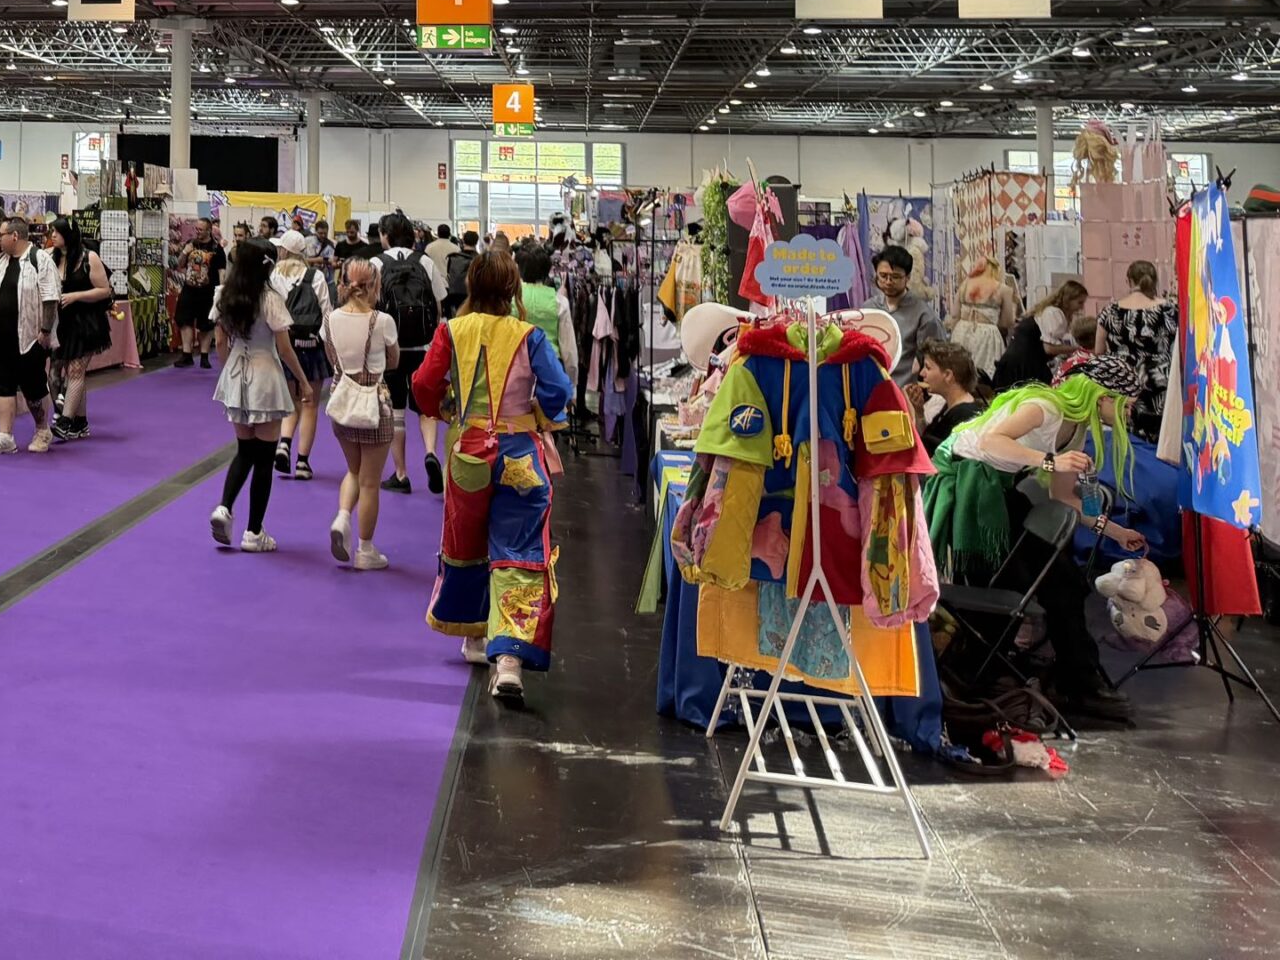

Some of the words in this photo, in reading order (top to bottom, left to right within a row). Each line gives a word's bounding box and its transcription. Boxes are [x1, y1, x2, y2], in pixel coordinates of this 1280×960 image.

[505, 91, 522, 113] 4
[773, 247, 816, 260] Made
[819, 248, 837, 261] to
[783, 262, 826, 276] order
[294, 338, 317, 348] PUMA
